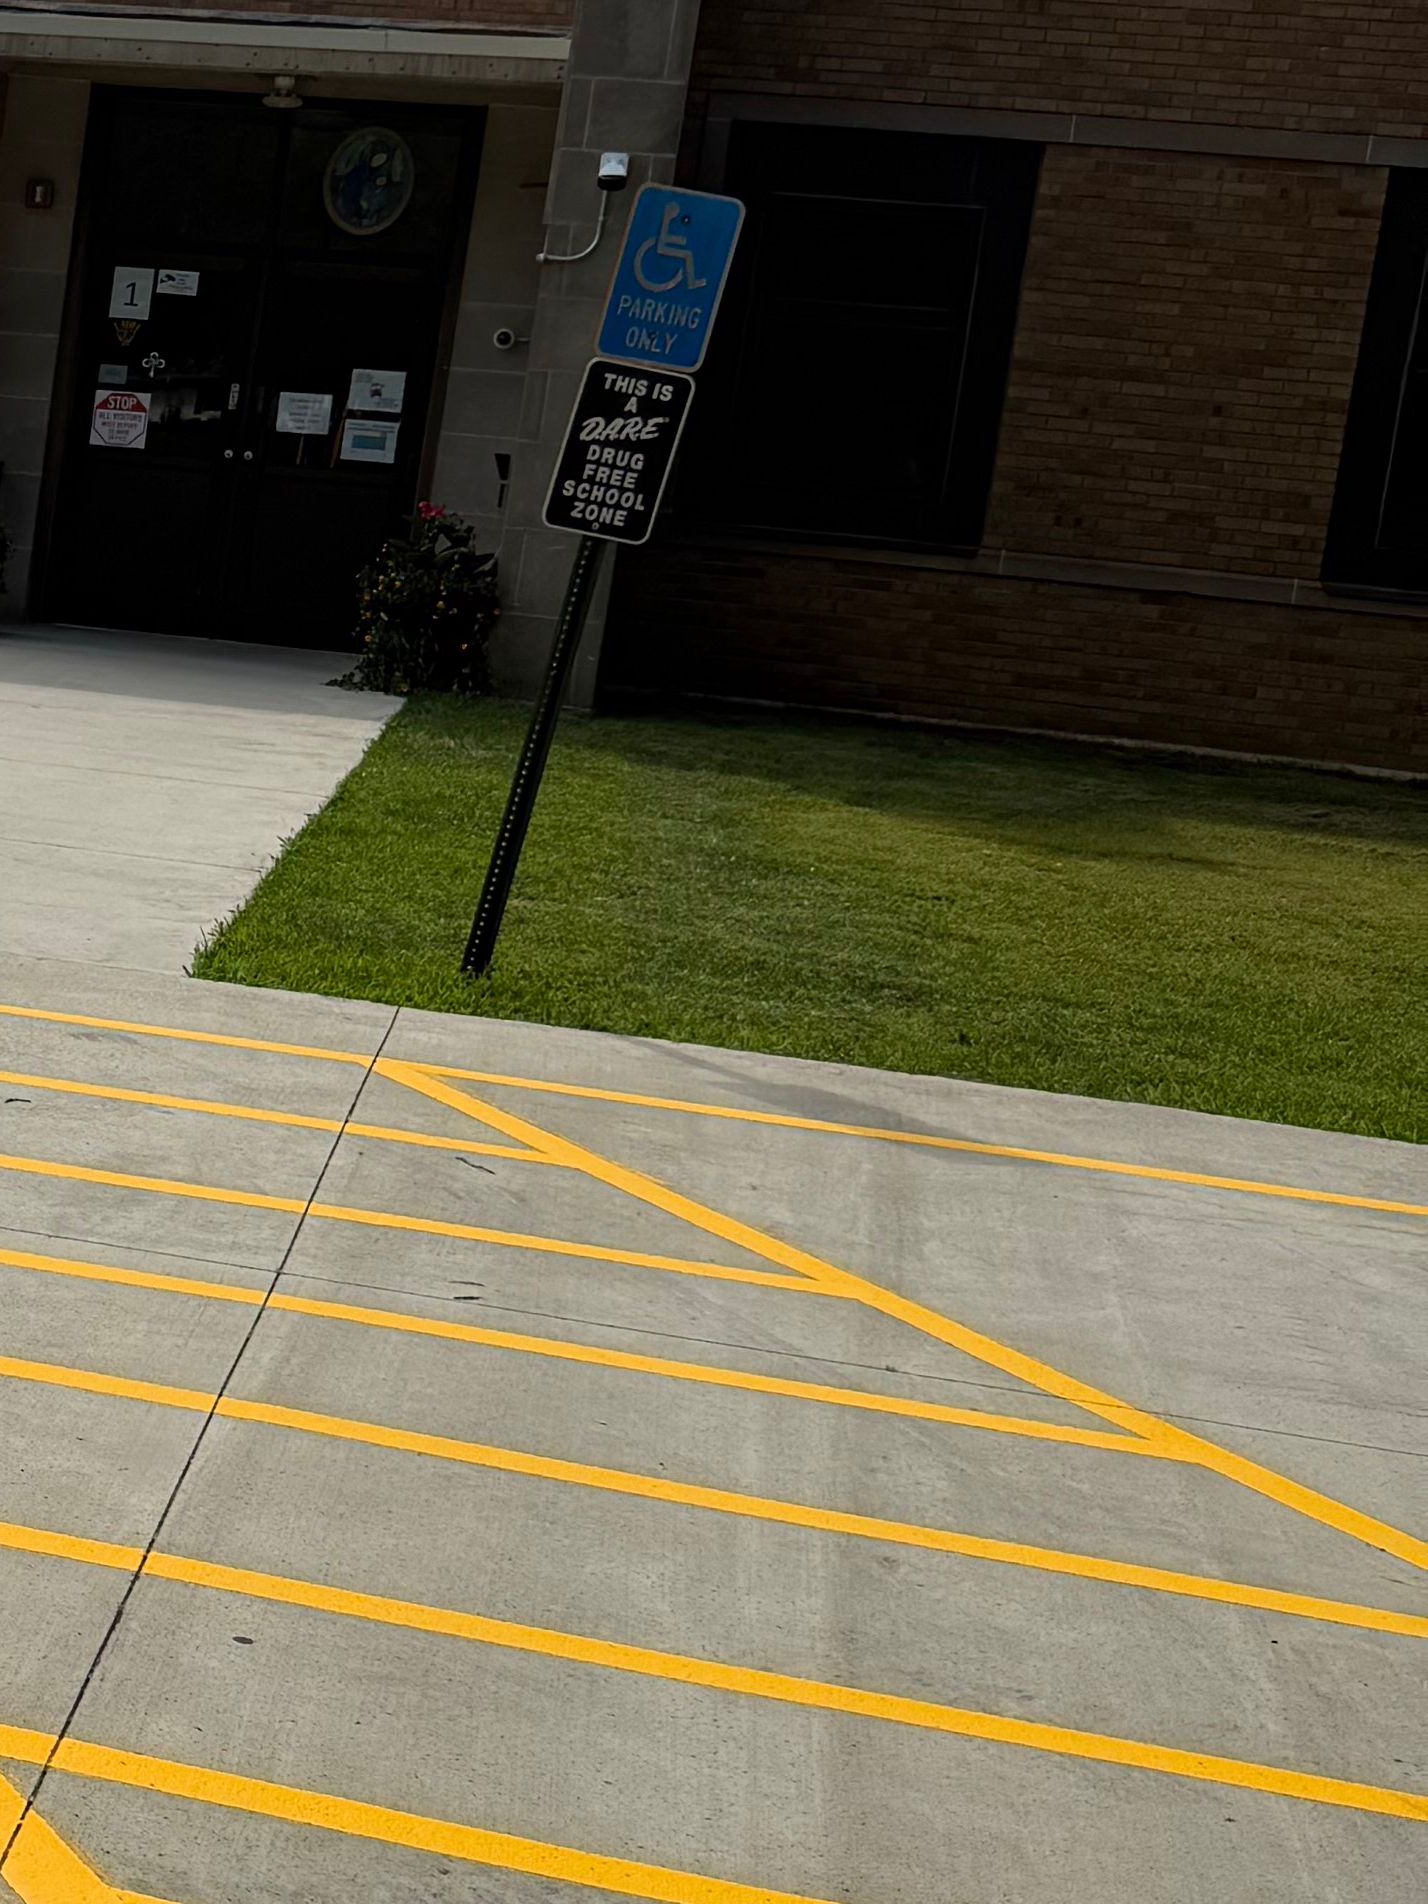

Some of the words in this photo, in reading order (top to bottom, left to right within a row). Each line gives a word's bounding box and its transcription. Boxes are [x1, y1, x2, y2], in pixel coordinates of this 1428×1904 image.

[123, 281, 139, 307] 1
[617, 295, 702, 330] PARKING
[625, 326, 679, 356] ONLY
[603, 372, 649, 397] THIS
[652, 382, 674, 402] IS
[107, 395, 138, 410] STOP
[623, 396, 639, 414] A
[585, 444, 646, 471] DRUG
[582, 463, 639, 490] FREE
[561, 480, 646, 512] SCHOOL
[570, 501, 629, 527] ZONE
